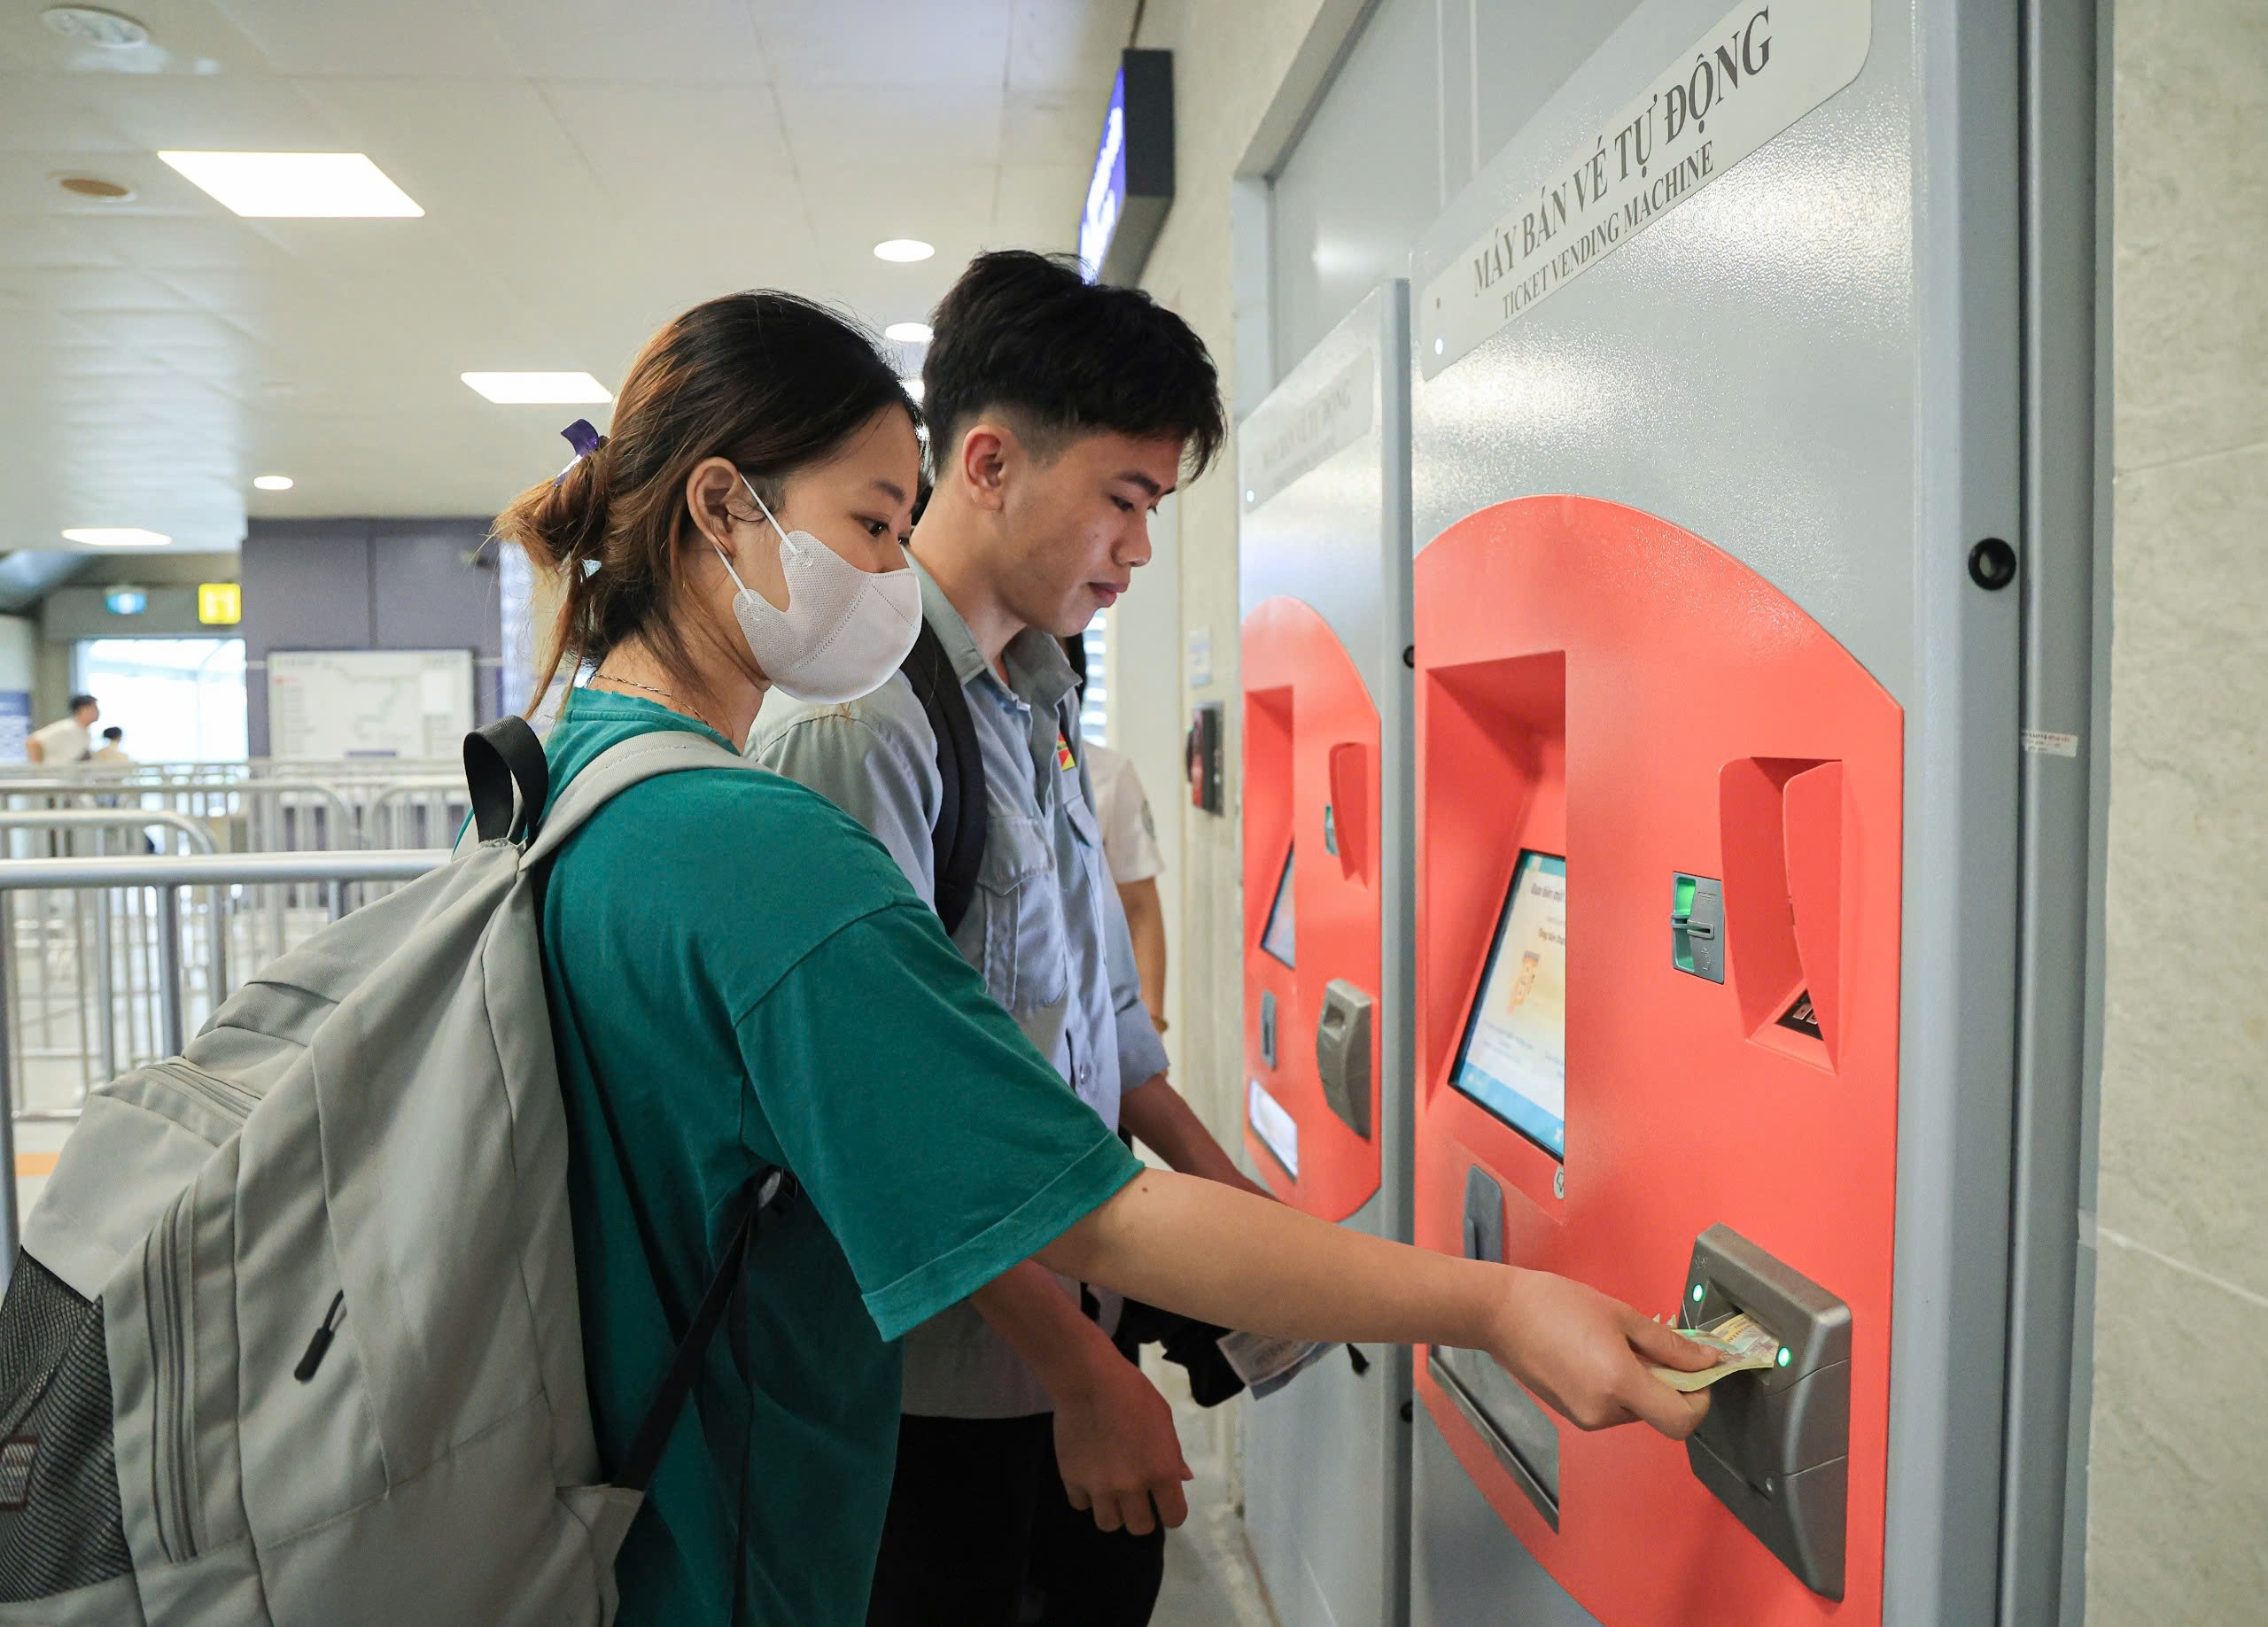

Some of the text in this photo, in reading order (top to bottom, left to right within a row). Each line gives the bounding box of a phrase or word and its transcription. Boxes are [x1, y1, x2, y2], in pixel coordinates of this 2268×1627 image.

[1474, 5, 1773, 297] MÁY BÁN VÉ TỰ ĐỘNG
[1503, 140, 1713, 319] TICKET VENDING MACHINE
